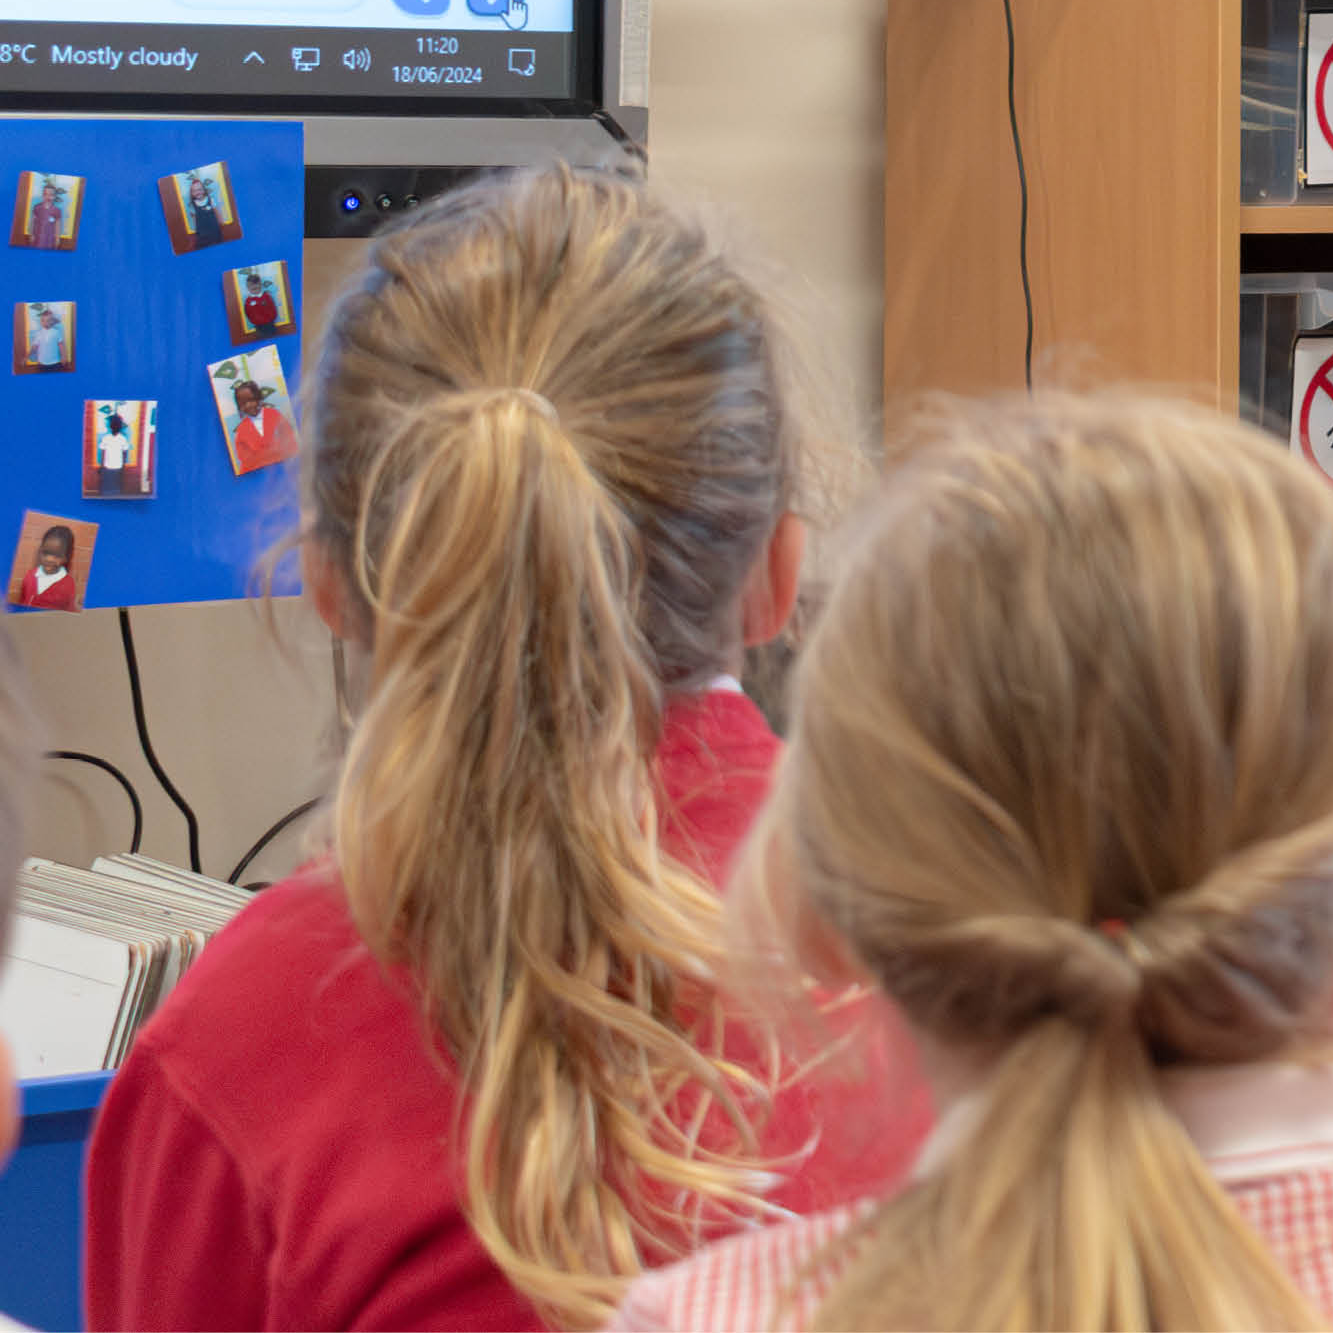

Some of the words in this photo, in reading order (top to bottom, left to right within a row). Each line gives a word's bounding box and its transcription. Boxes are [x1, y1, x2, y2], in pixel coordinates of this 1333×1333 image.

[416, 37, 459, 54] 11:20
[51, 45, 123, 70] Mostly
[129, 46, 199, 71] cloudy
[392, 66, 482, 84] 18/06/2024
